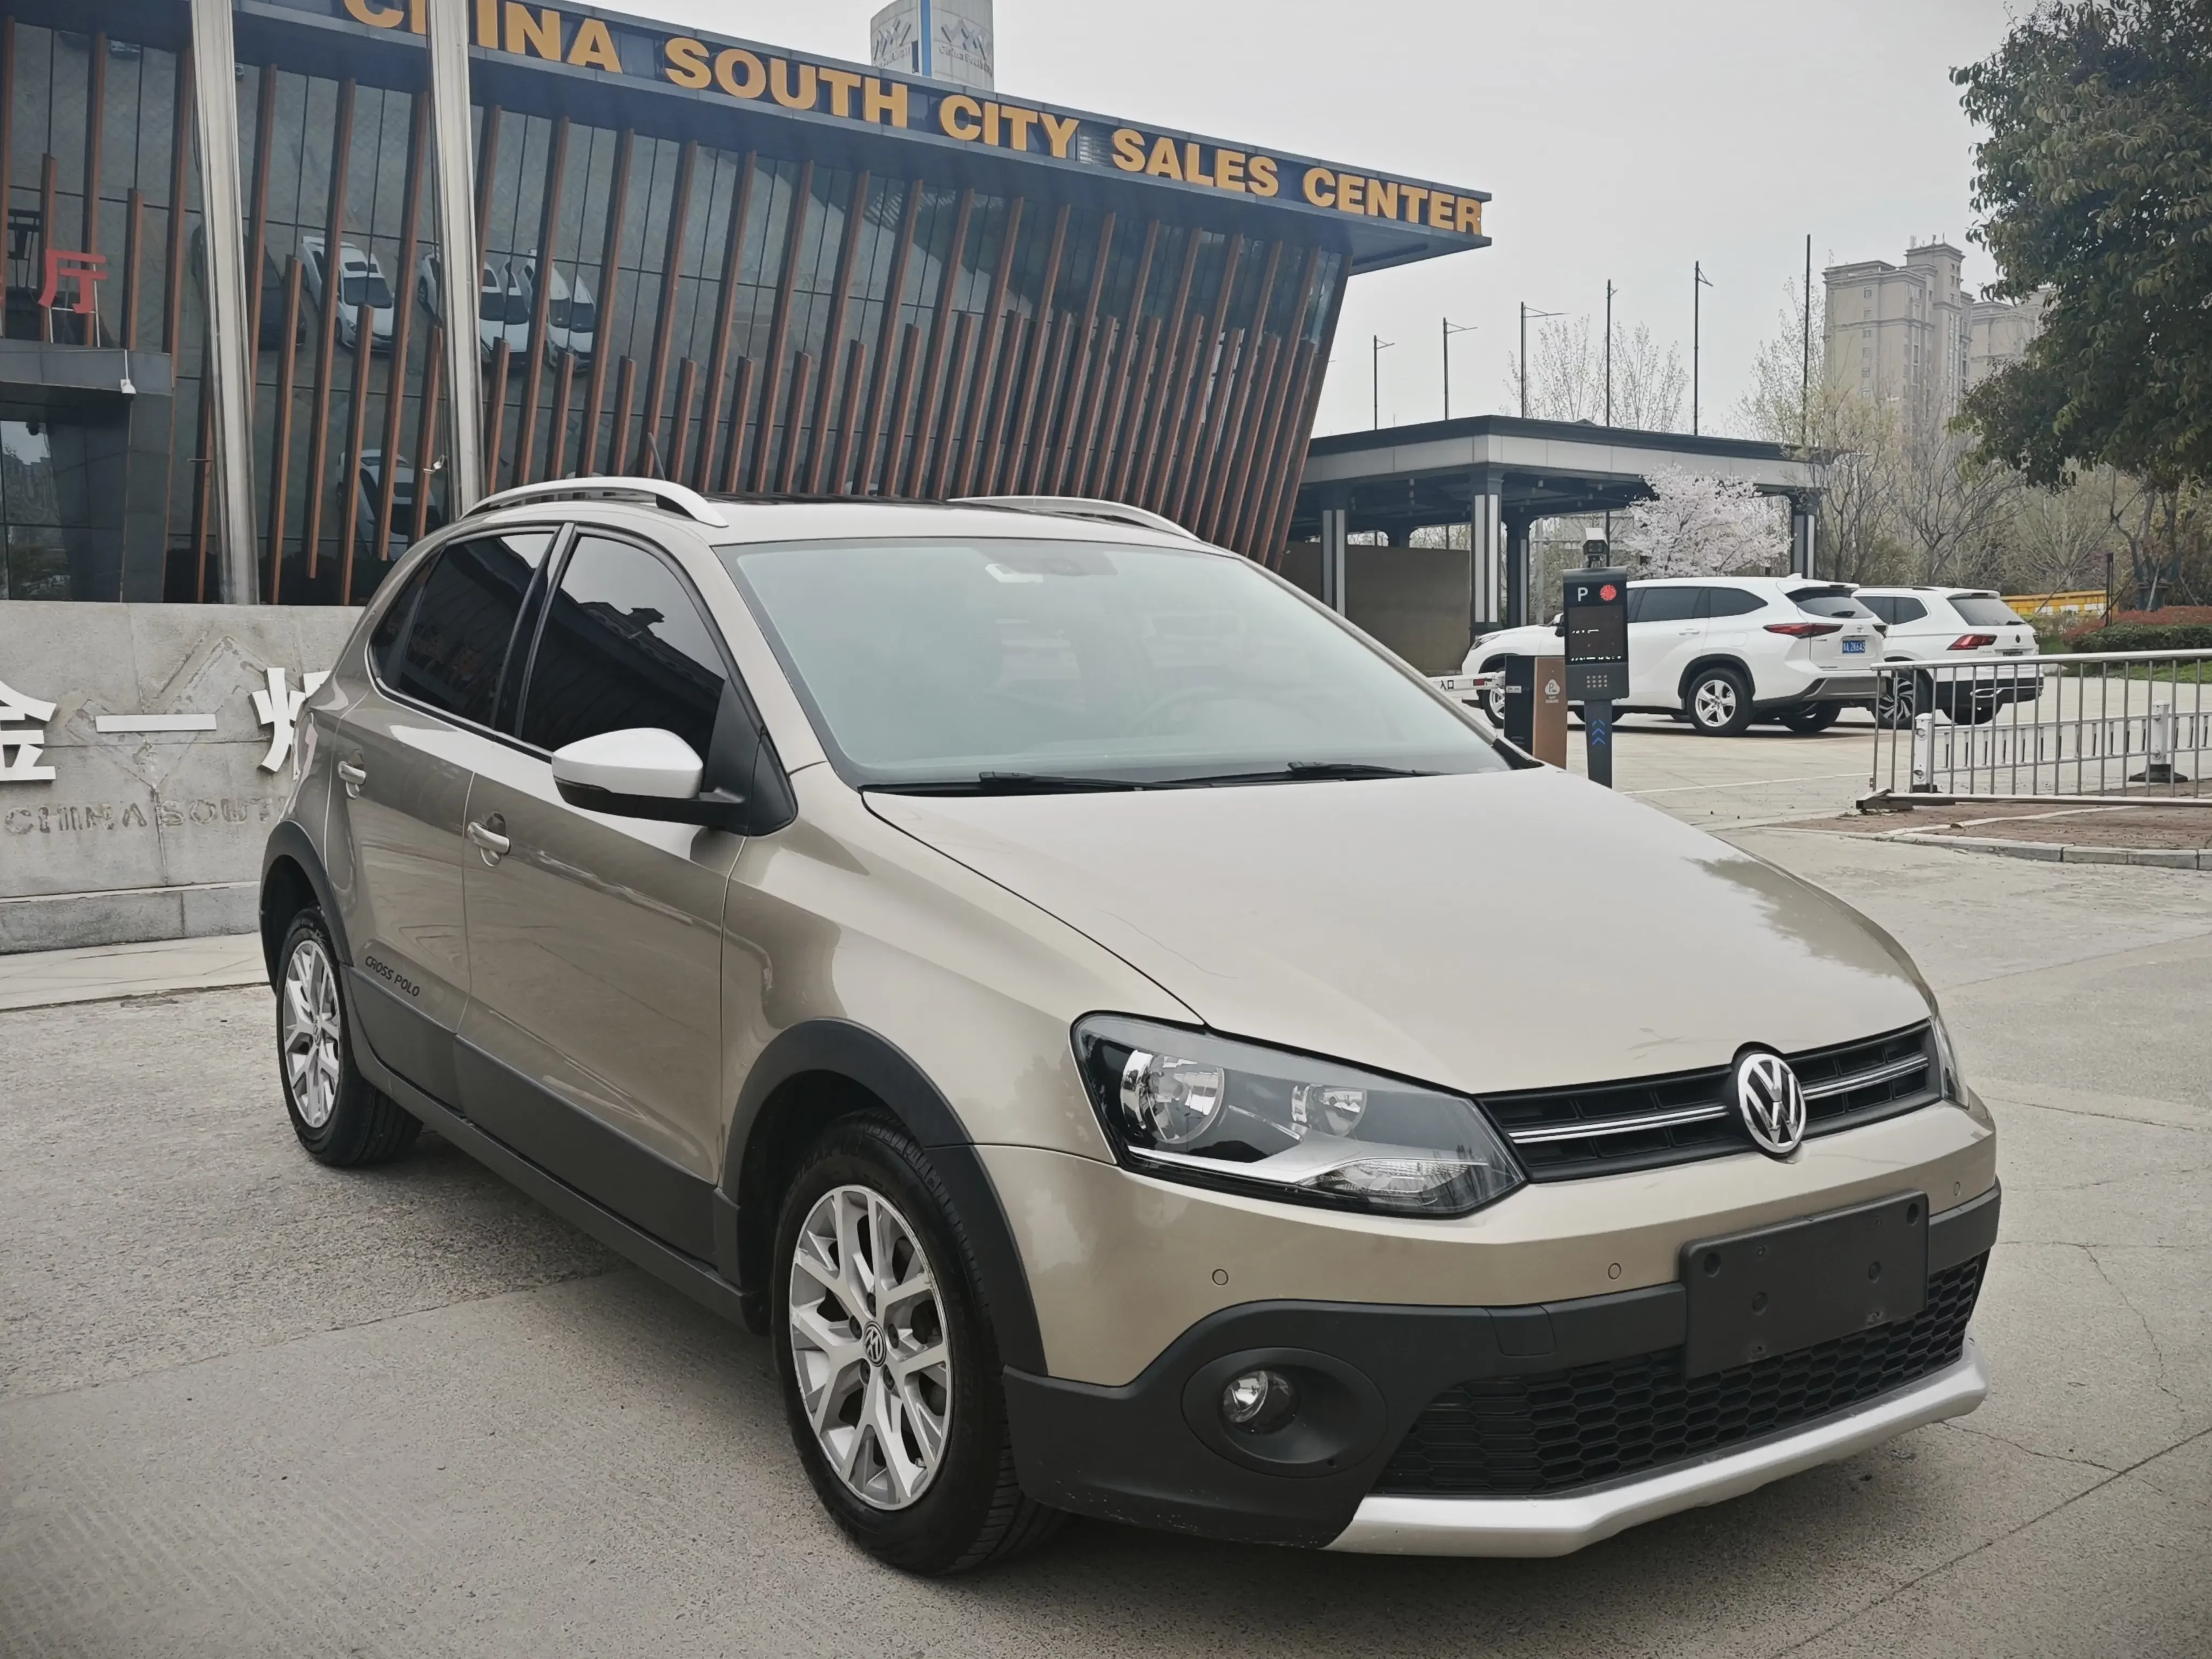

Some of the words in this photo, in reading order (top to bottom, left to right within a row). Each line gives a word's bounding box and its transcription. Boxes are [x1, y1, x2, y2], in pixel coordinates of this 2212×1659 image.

[344, 0, 623, 73] CINA
[664, 37, 908, 127] SOUTH
[939, 95, 1079, 159] CITY
[1111, 129, 1279, 197] SALES
[1302, 167, 1482, 235] CENTER
[38, 249, 106, 313] 厅
[1577, 587, 1588, 602] P
[1440, 680, 1454, 690] 入口
[365, 955, 394, 981] CROSS
[394, 974, 420, 997] POLO
